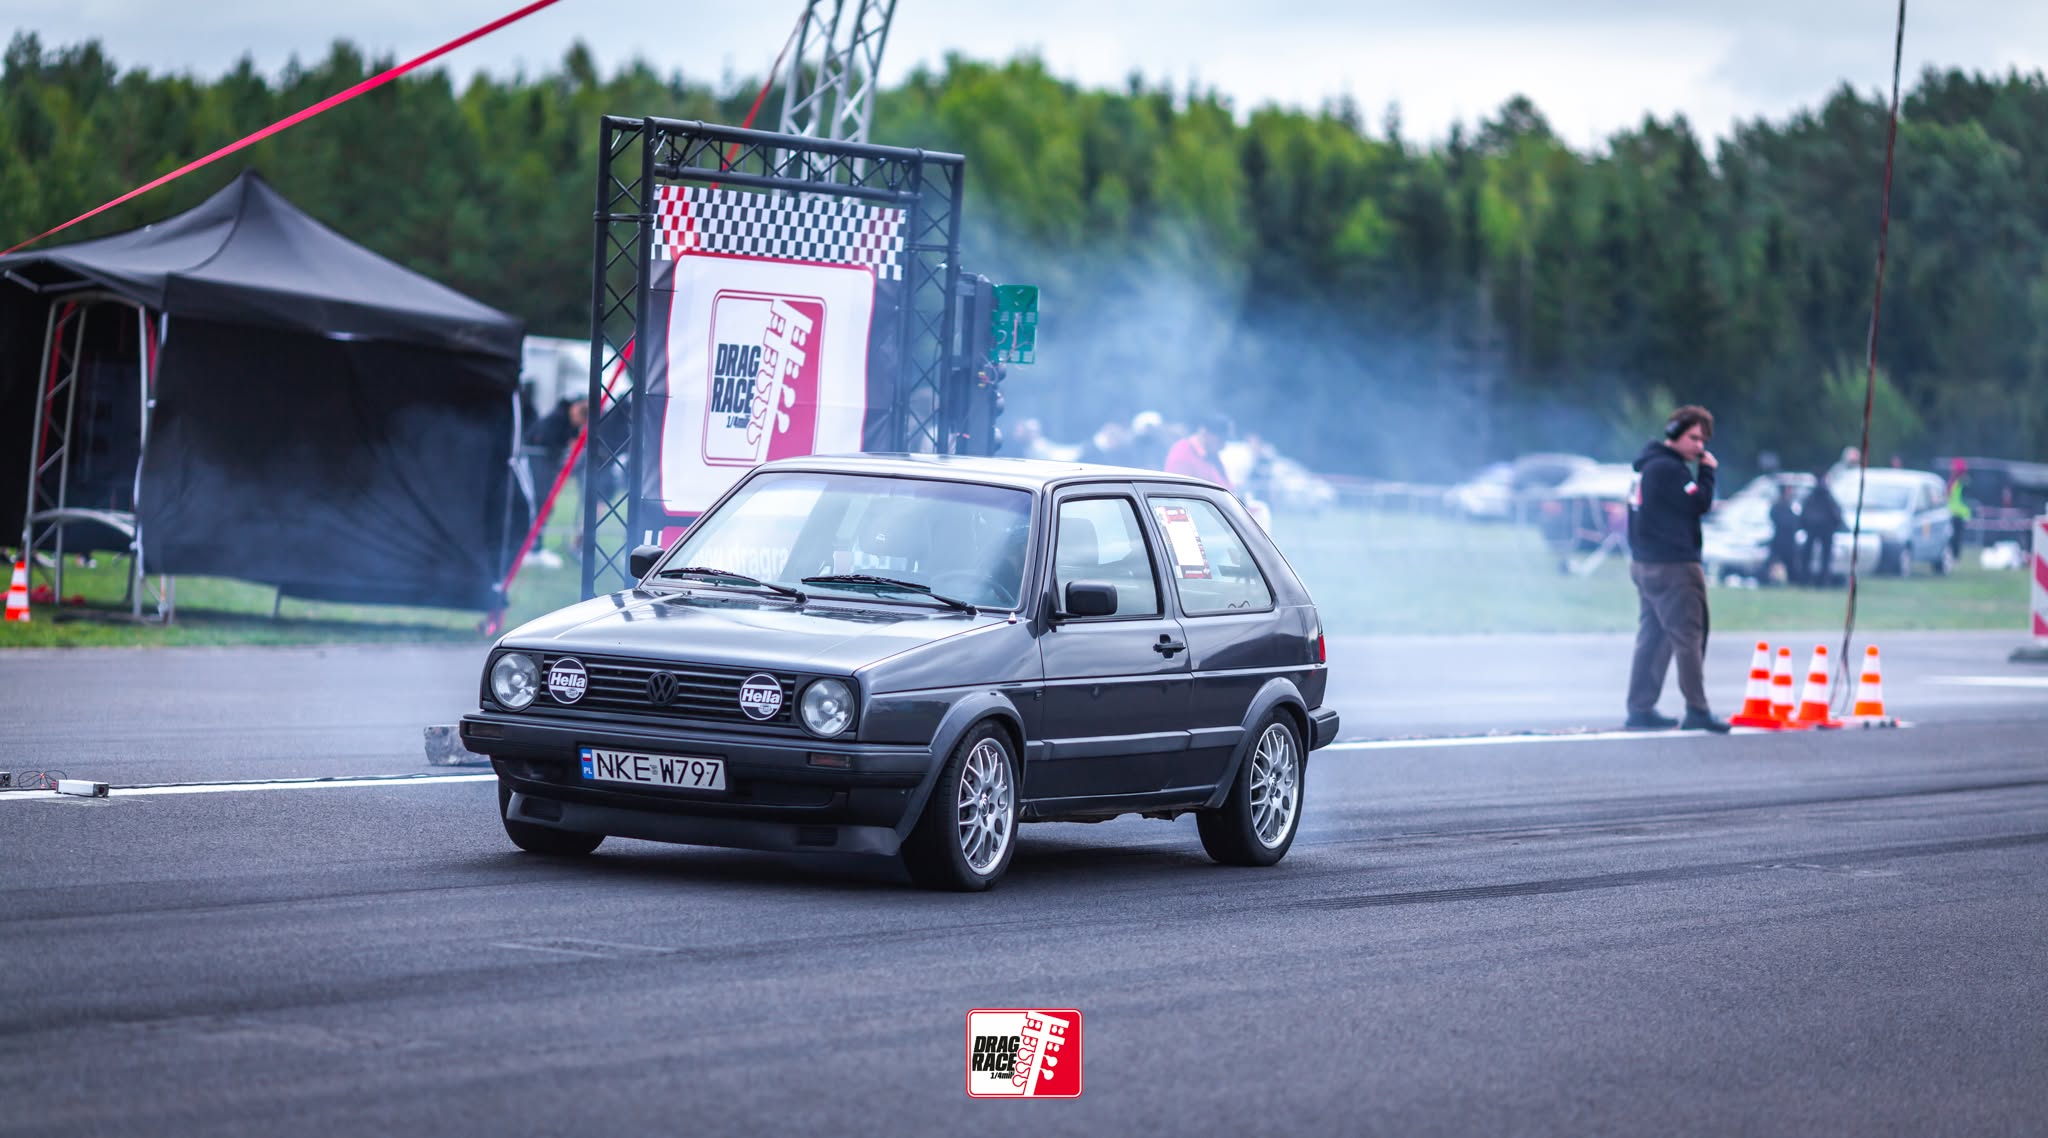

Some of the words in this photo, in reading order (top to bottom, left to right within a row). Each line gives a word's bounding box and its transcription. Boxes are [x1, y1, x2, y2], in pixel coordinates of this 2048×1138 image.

[715, 343, 761, 378] DRAG
[711, 377, 756, 414] RACE
[550, 672, 586, 688] Hella
[742, 688, 780, 704] Hella
[583, 766, 592, 775] PL
[596, 752, 651, 782] NKE
[659, 758, 719, 787] W797
